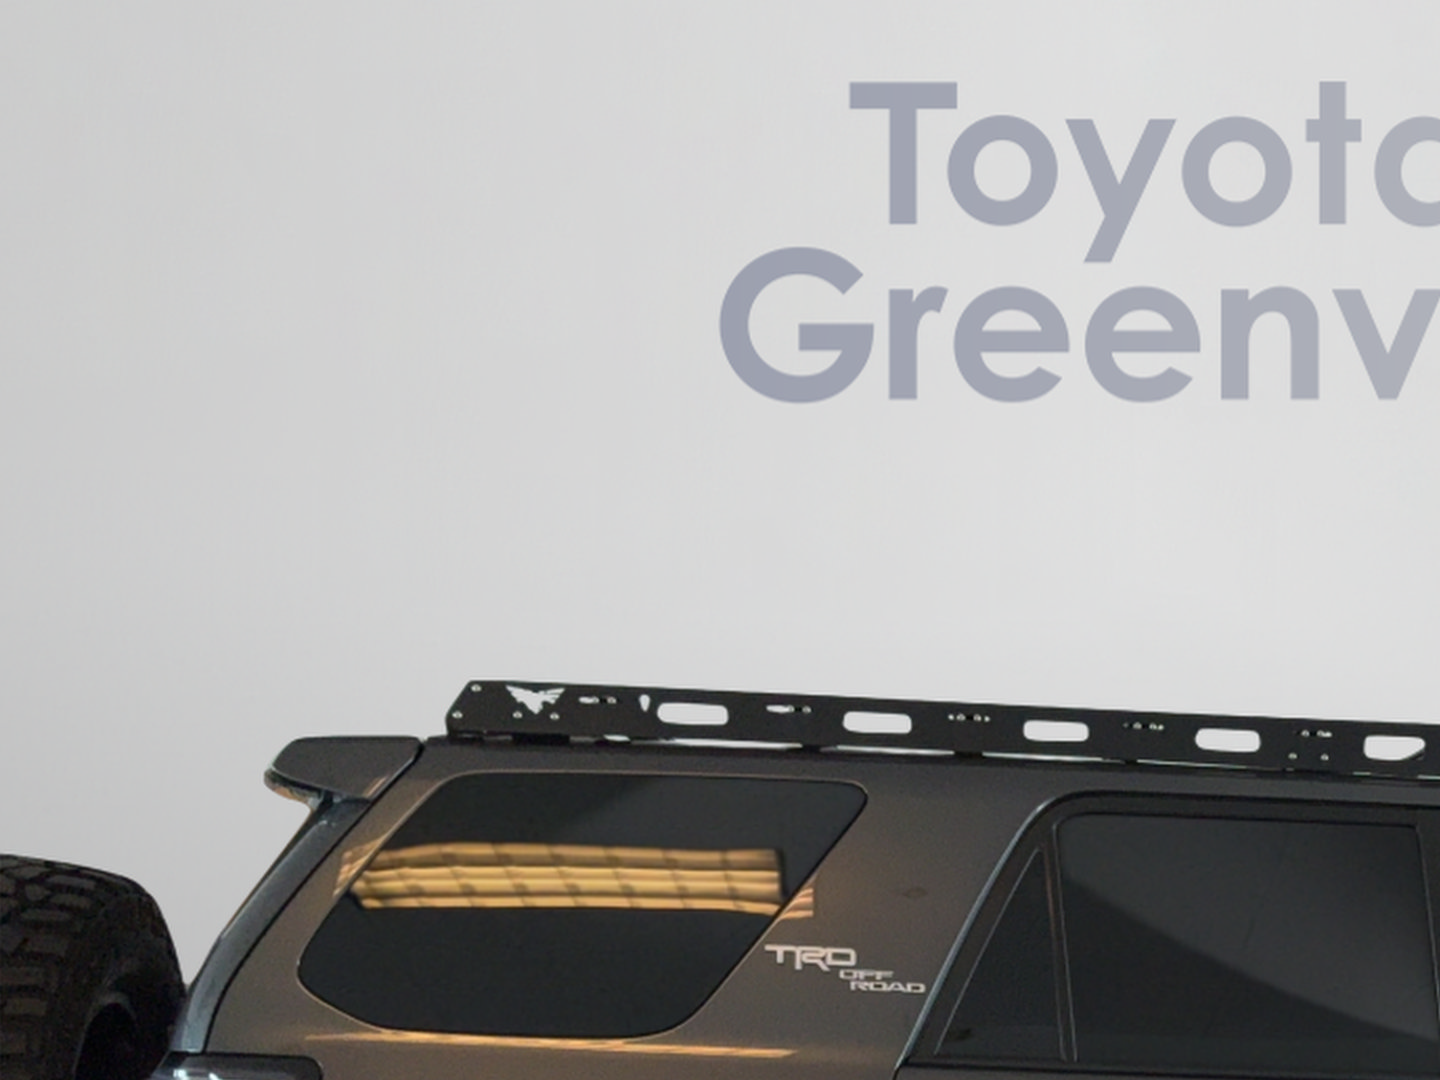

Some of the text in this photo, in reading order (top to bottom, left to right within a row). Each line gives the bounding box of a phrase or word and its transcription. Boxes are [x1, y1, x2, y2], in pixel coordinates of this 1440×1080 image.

[764, 944, 857, 971] TRD
[839, 968, 894, 981] OFF
[850, 980, 926, 994] ROAD
